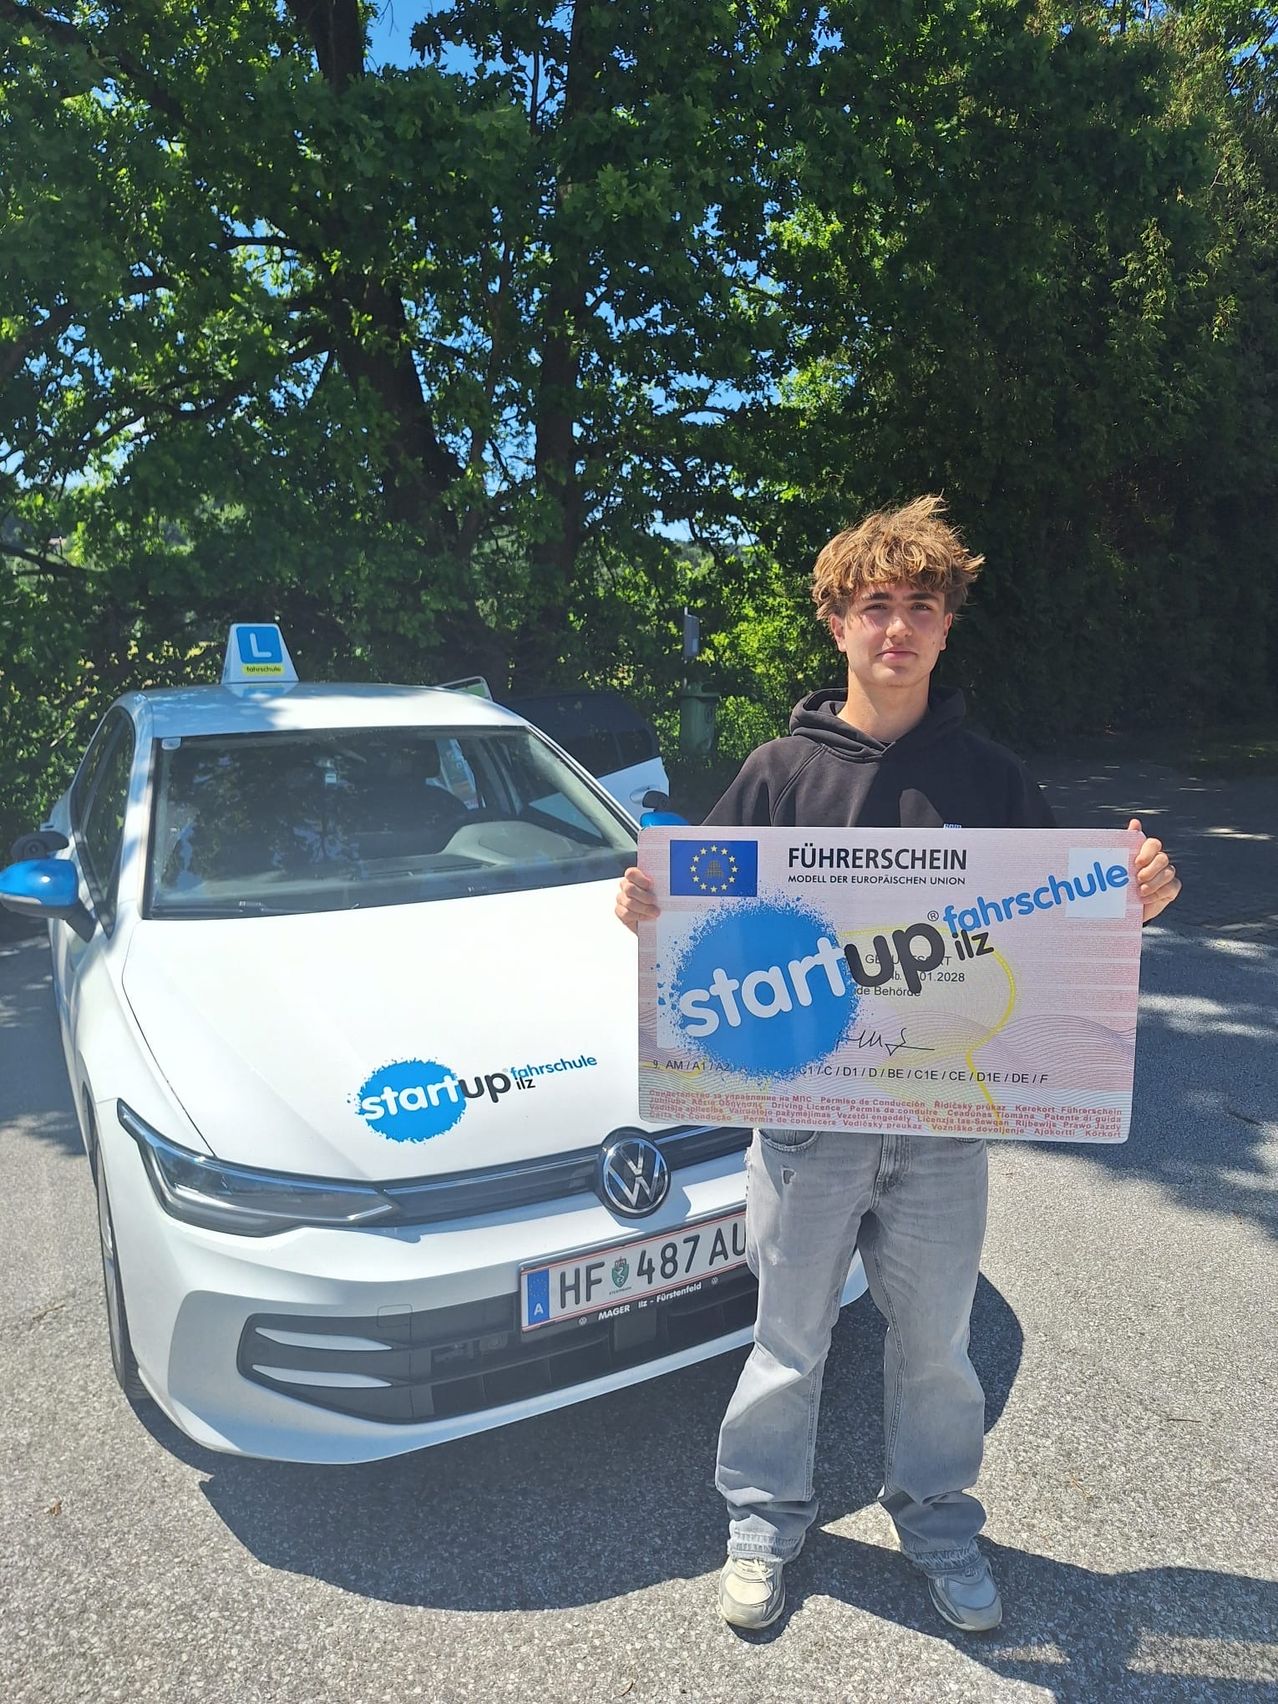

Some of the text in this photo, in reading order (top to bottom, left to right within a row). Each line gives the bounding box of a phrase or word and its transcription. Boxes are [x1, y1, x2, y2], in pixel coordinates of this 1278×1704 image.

[249, 632, 273, 658] L
[246, 665, 282, 673] fahrschule
[788, 843, 967, 870] FÜHRERSCHEIN
[788, 874, 966, 885] MODELL DER EUROPÄISCHEN UNION
[943, 861, 1130, 934] fahrschule
[951, 929, 995, 961] ilz
[666, 1060, 683, 1070] AM
[692, 1061, 706, 1071] A1
[716, 1062, 730, 1072] A2
[824, 1066, 833, 1075] C
[843, 1067, 857, 1077] D1
[869, 1068, 878, 1078] D
[887, 1068, 904, 1078] BE
[914, 1069, 938, 1080] C1E
[949, 1071, 966, 1081] CE
[976, 1072, 1001, 1083] D1E
[1012, 1073, 1029, 1084] DE
[1039, 1074, 1049, 1084] F
[361, 1055, 597, 1120] startup fahrschule
[515, 1077, 536, 1091] ilz
[533, 1222, 747, 1316] A HF 487 AU
[597, 1304, 631, 1321] MAGER
[656, 1282, 702, 1303] Fürstenfeld
